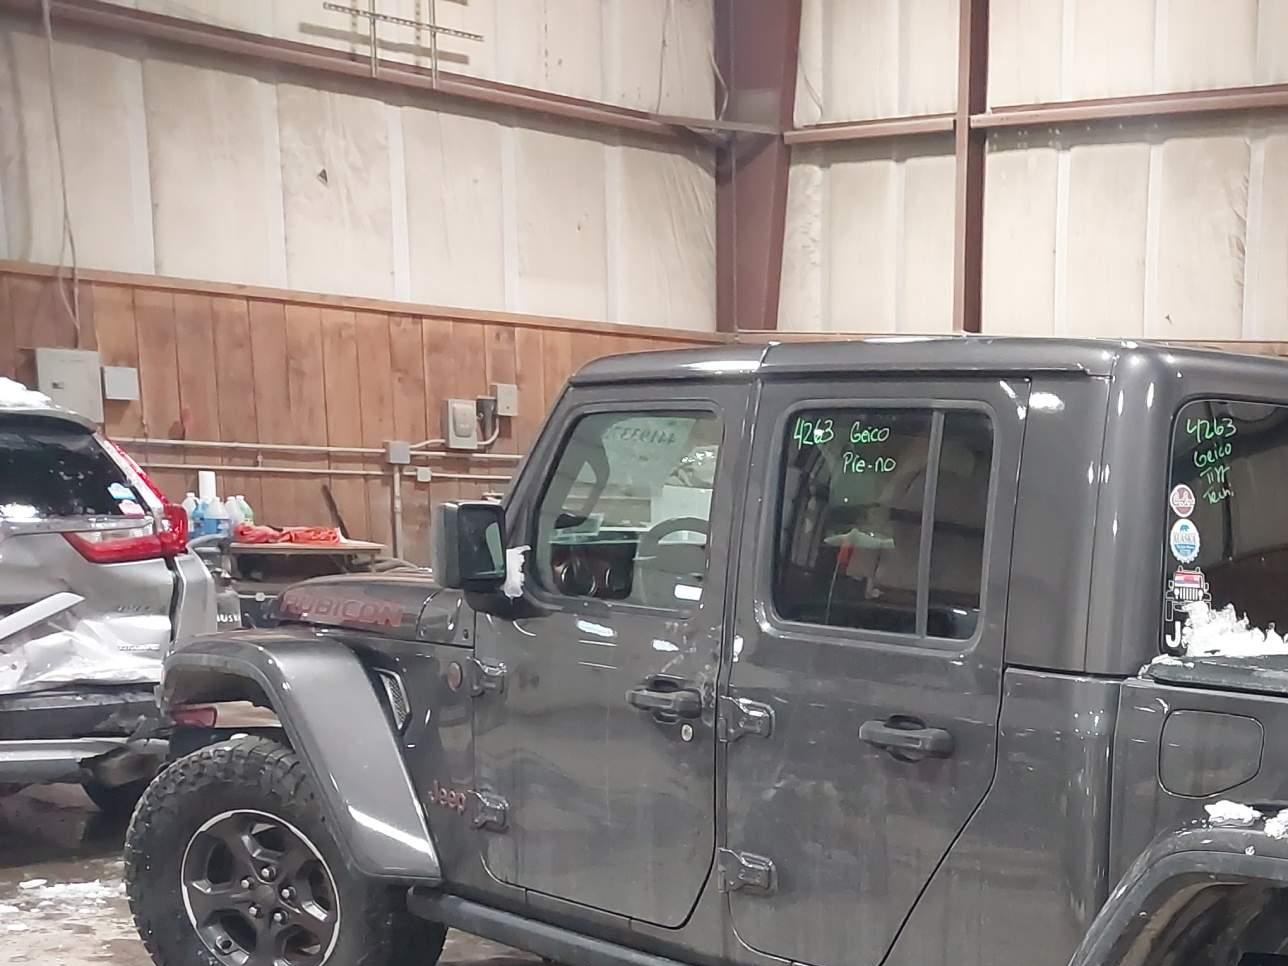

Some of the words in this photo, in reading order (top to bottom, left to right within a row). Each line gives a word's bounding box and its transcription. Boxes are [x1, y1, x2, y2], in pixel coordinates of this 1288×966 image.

[793, 416, 835, 450] 4263
[1186, 415, 1237, 443] 4263
[279, 592, 402, 628] RUBICON
[428, 780, 466, 816] Jeep
